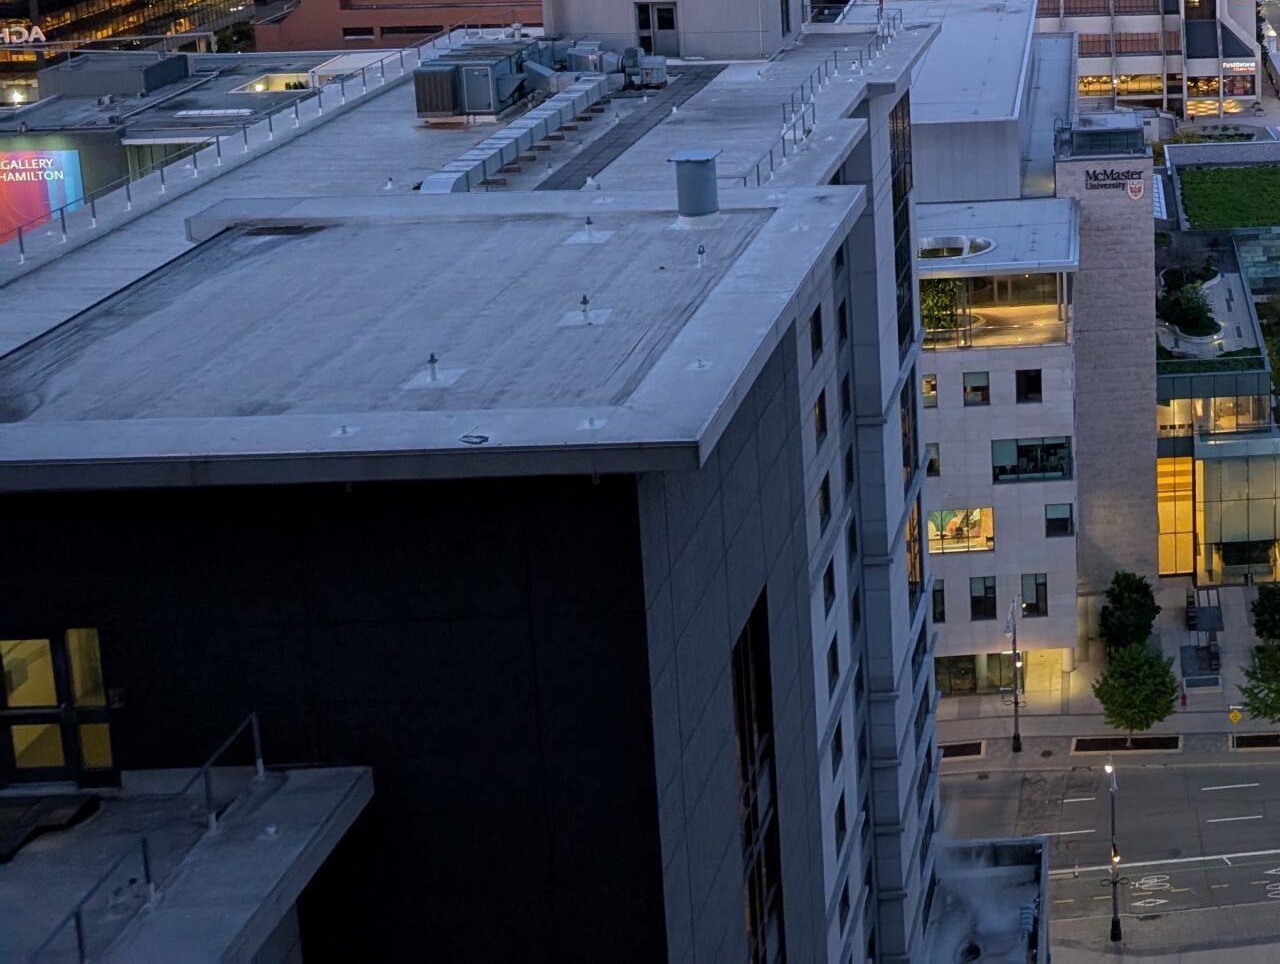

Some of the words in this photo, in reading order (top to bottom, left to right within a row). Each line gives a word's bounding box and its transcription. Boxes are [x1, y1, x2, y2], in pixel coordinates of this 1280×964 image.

[0, 158, 54, 170] GALLERY
[1085, 169, 1144, 181] McMaster
[1085, 182, 1127, 191] University
